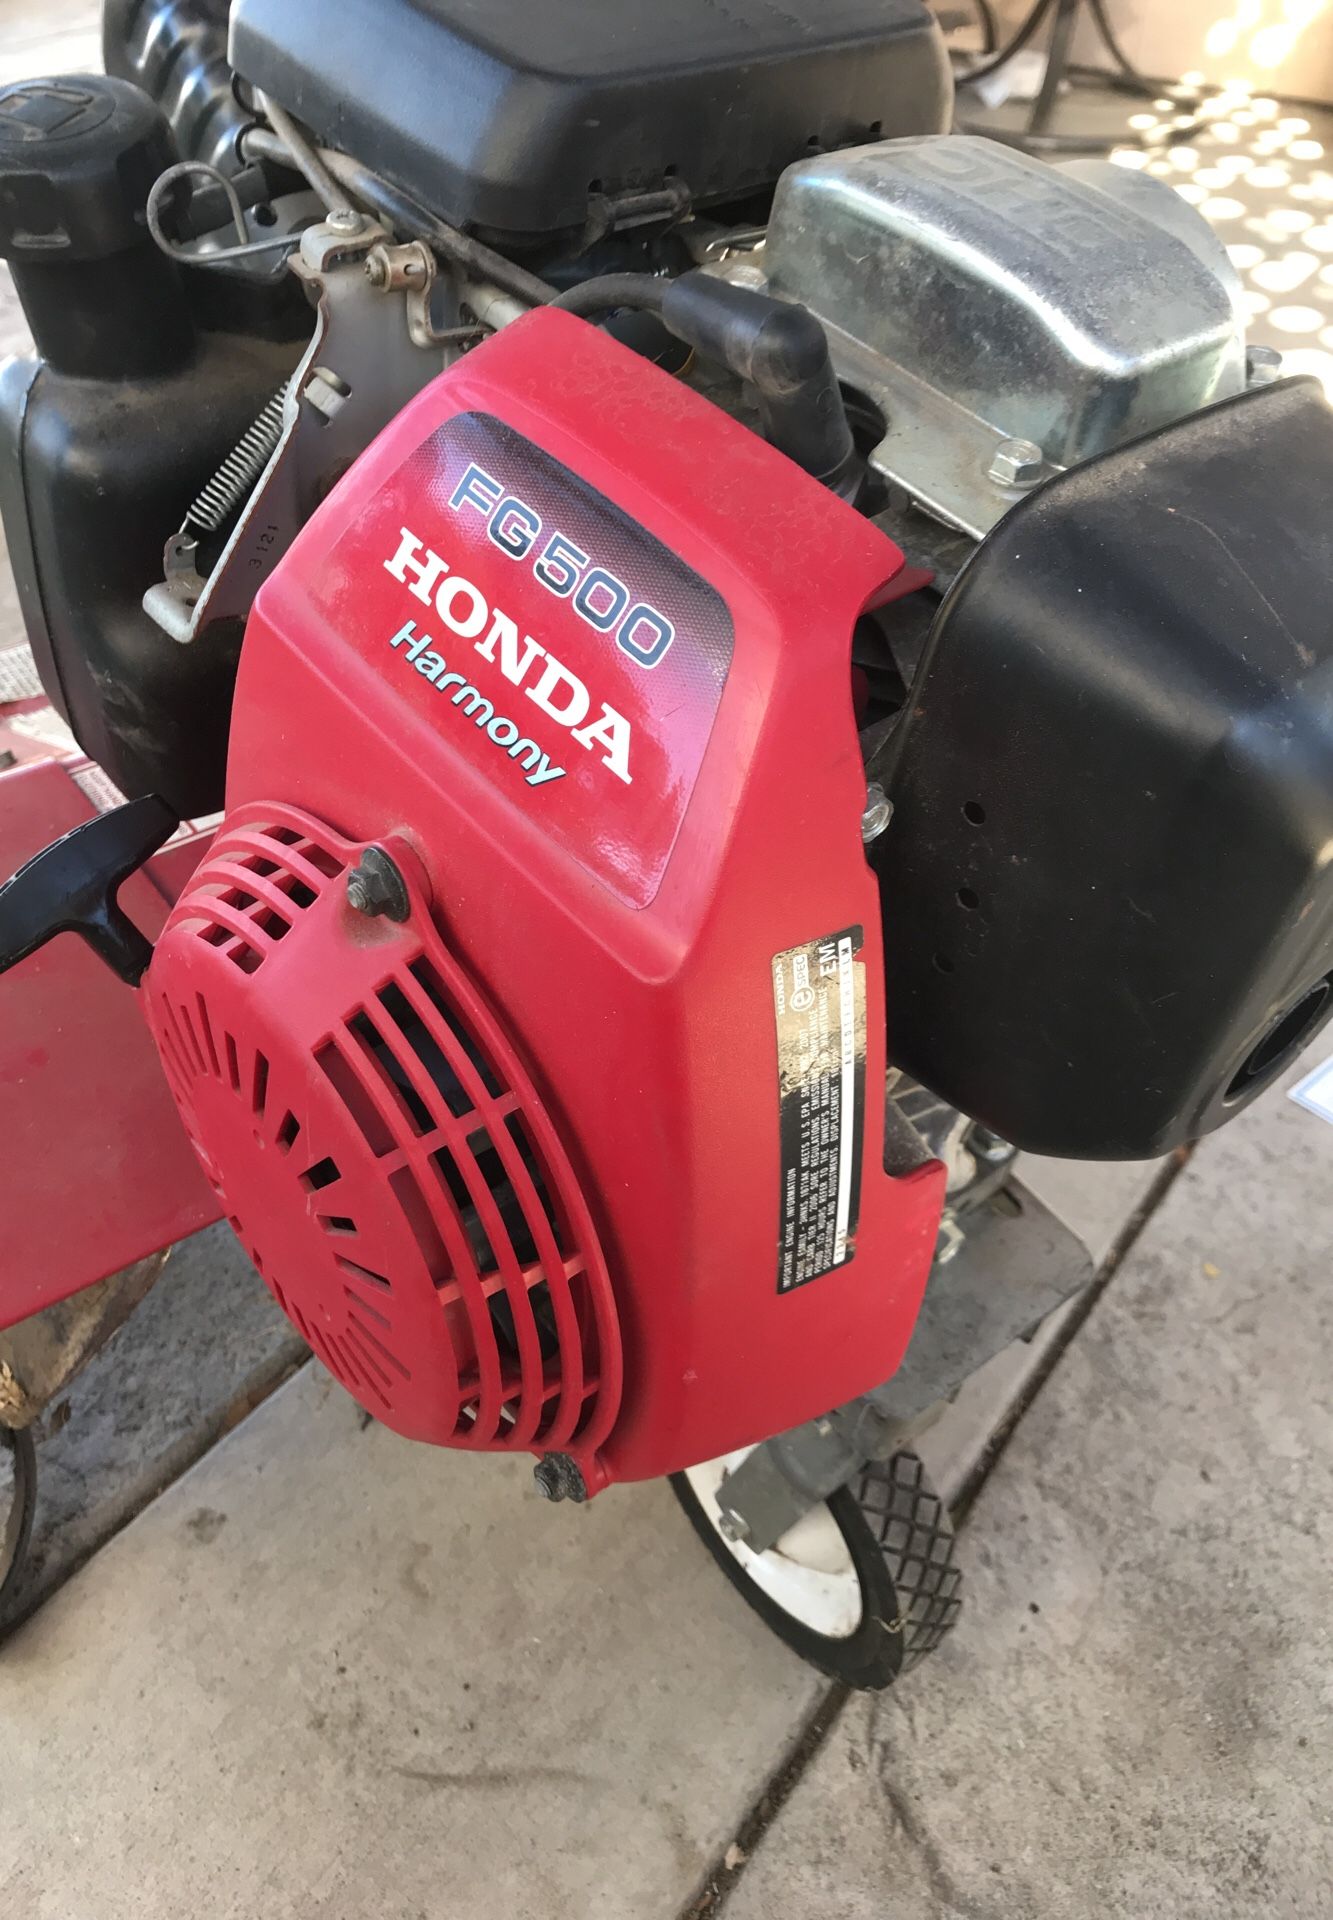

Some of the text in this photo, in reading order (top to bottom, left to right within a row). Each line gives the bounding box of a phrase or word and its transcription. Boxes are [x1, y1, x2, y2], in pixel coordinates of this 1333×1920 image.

[382, 527, 633, 785] HONDA
[389, 620, 567, 786] Harmony
[795, 956, 806, 987] SPEC
[818, 942, 838, 977] EM
[775, 963, 785, 1016] HONDA
[820, 1073, 830, 1107] MANUAL
[820, 1110, 830, 1145] OWNER'S
[830, 1085, 839, 1142] DISPLACEMENT
[801, 1142, 810, 1167] MEETS
[820, 1149, 829, 1164] THE
[810, 1171, 819, 1190] SORE
[820, 1167, 829, 1178] TO
[819, 1181, 828, 1204] REFER
[783, 1168, 796, 1288] IMPORTANT ENGINE INFORMATION
[807, 1224, 816, 1240] TIER
[797, 1233, 807, 1257] FAMILY
